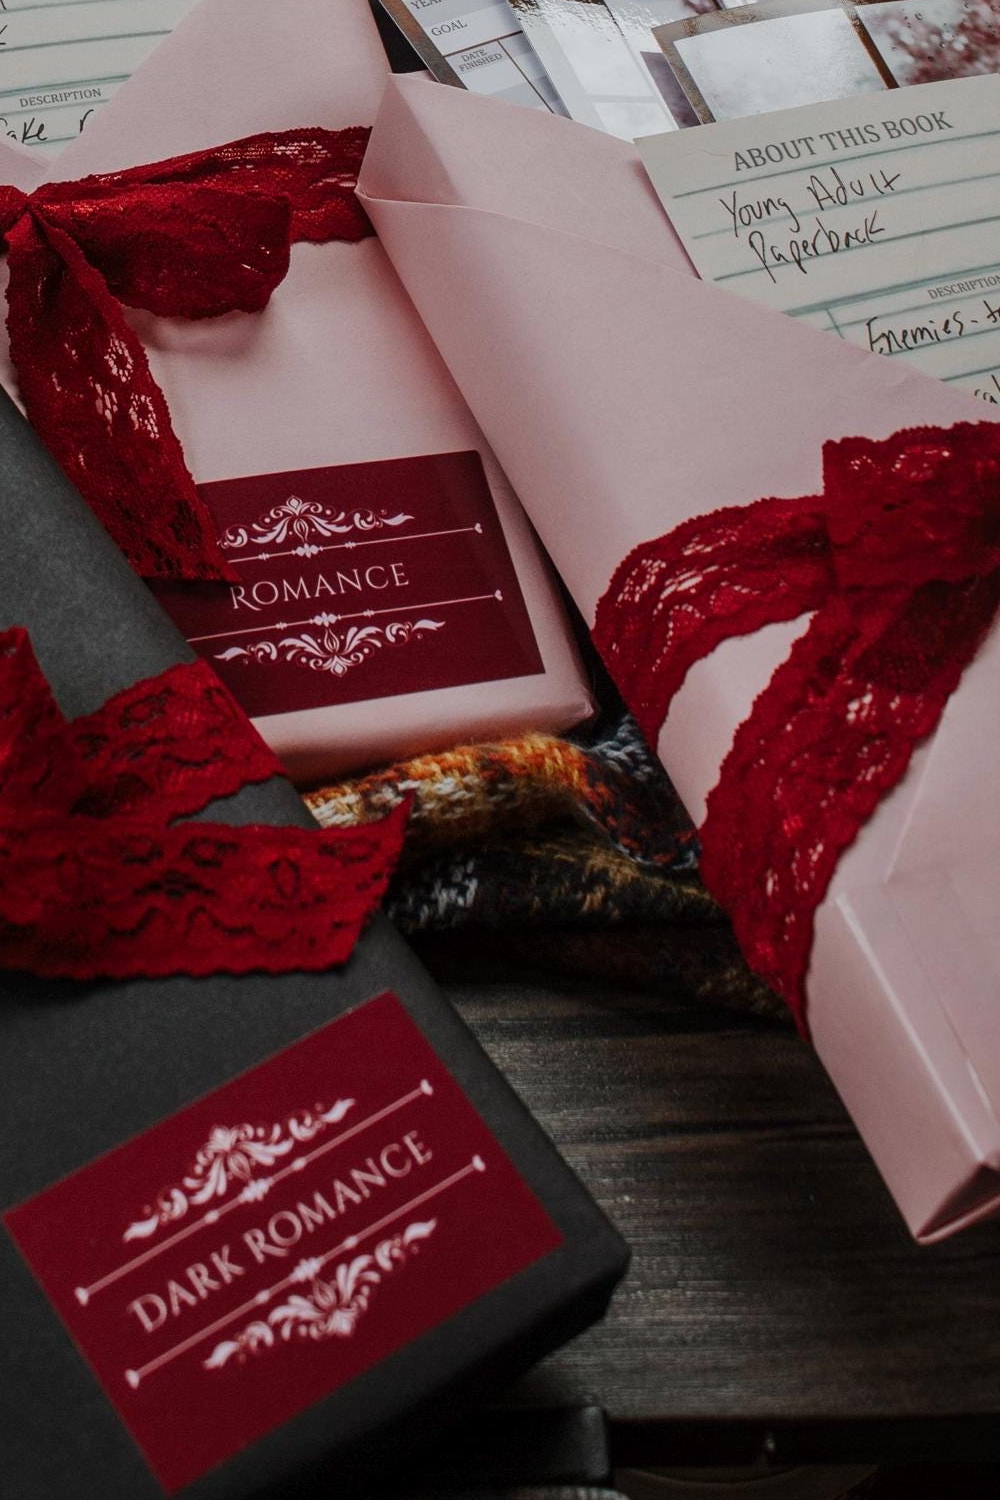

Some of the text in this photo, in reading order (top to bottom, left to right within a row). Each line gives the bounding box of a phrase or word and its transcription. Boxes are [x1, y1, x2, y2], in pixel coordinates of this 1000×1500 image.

[431, 19, 468, 37] GOAL
[459, 53, 503, 72] FINISHED
[461, 49, 487, 62] DATE
[19, 88, 102, 108] DESCRIPTION
[734, 111, 955, 171] ABOUT THIS BOOK
[719, 166, 901, 238] Young Adult
[748, 210, 885, 284] Paperback
[229, 563, 410, 612] ROMANCE
[126, 1129, 434, 1332] DARK ROMANCE
